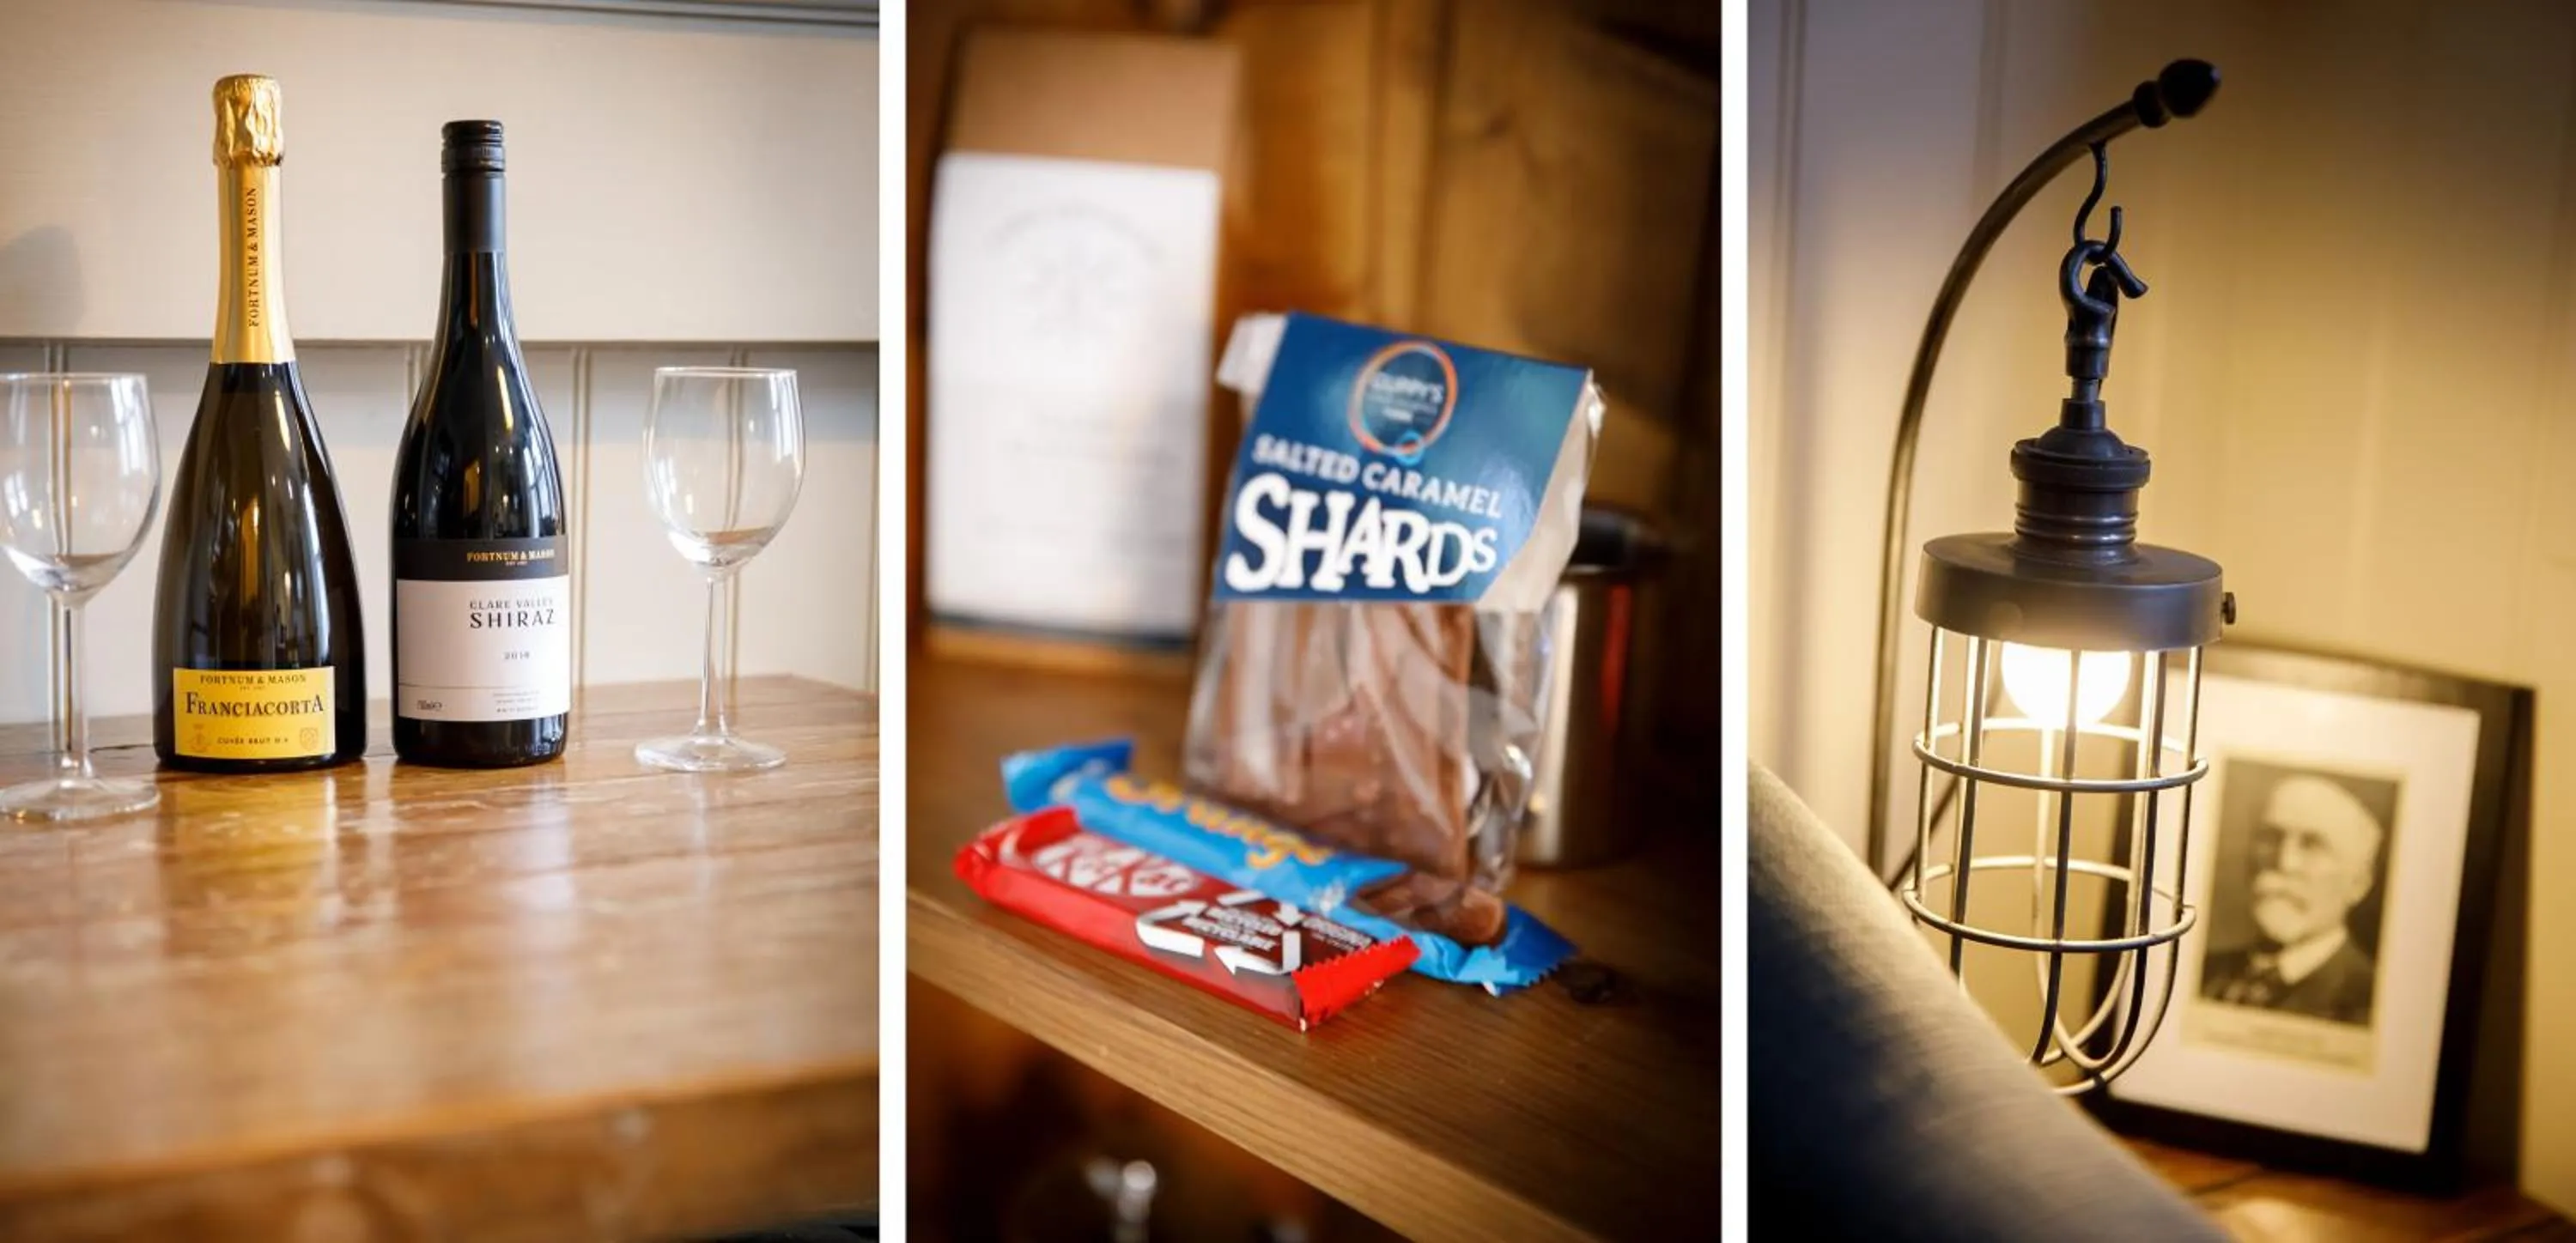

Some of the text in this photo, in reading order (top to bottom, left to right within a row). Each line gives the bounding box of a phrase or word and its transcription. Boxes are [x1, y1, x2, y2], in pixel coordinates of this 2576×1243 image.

[246, 188, 258, 238] MASON
[247, 256, 259, 327] FORTNUM
[1251, 433, 1359, 483] SALTED
[1362, 462, 1503, 518] CARAMEL
[1225, 472, 1498, 592] SHARDS
[466, 551, 519, 562] FORTNUM
[470, 599, 511, 609] CLARE
[470, 609, 556, 628] SHIRAZ
[200, 673, 307, 685] FORTNUM & MASON
